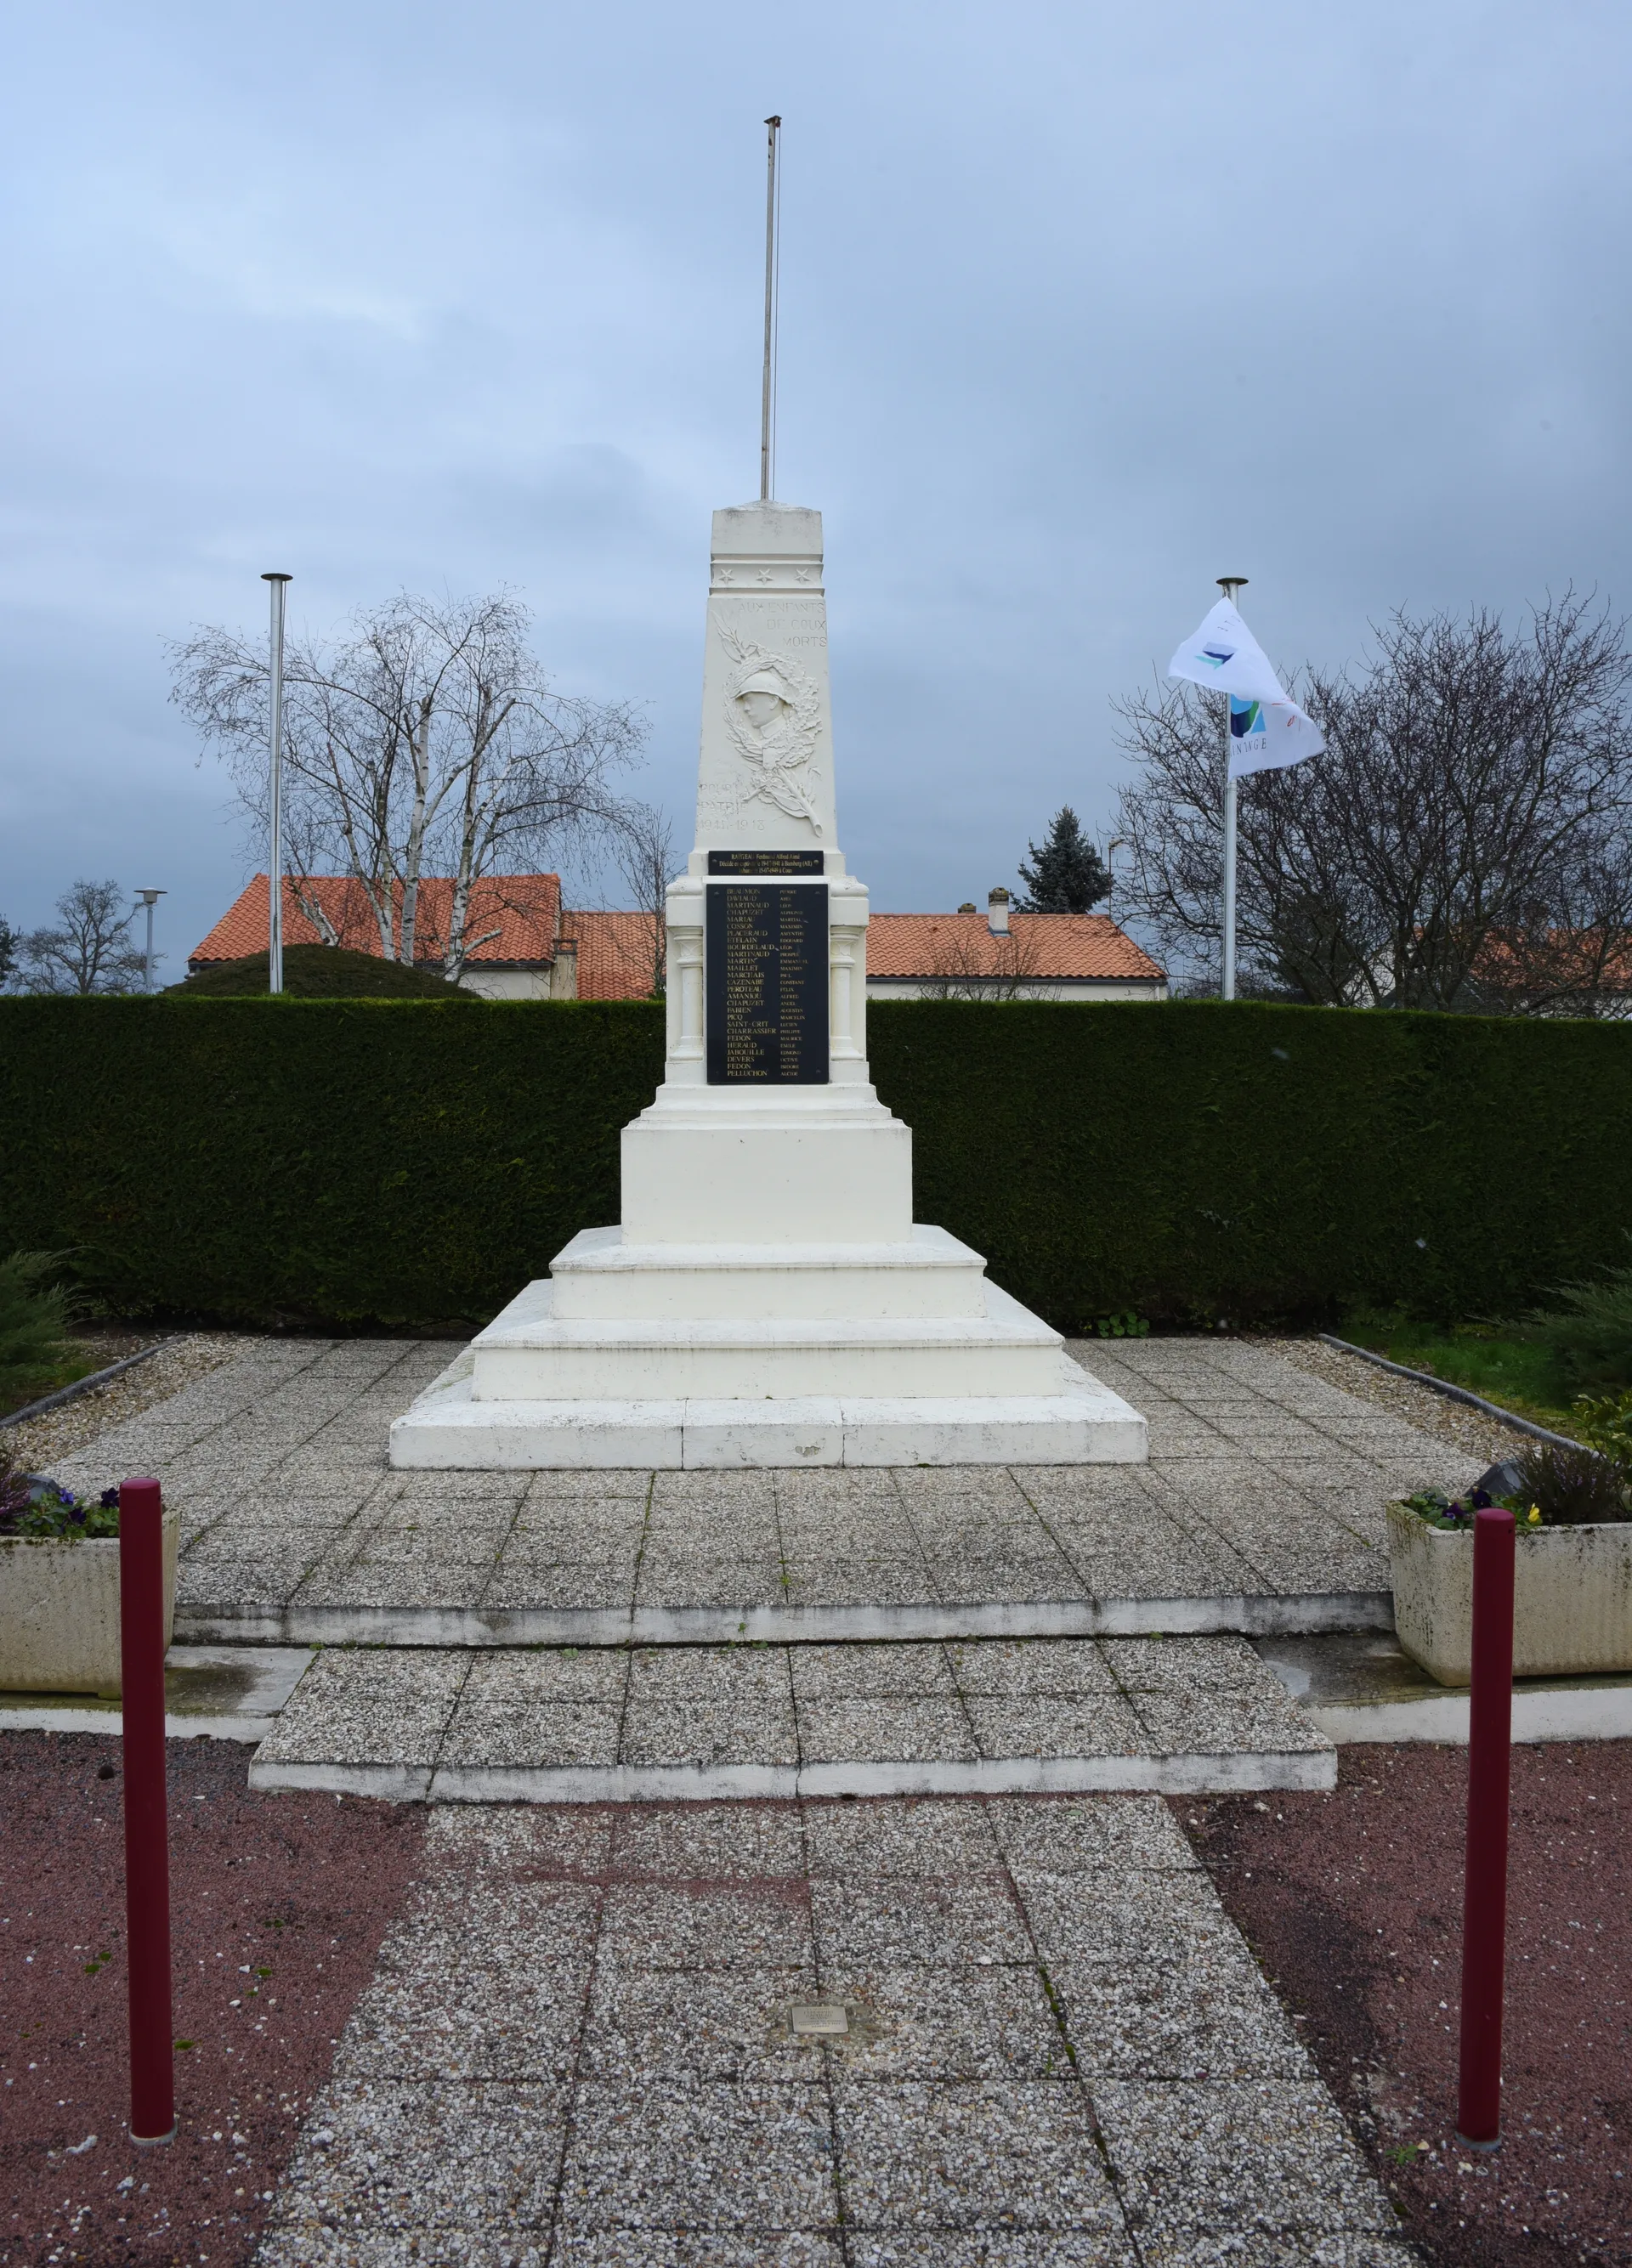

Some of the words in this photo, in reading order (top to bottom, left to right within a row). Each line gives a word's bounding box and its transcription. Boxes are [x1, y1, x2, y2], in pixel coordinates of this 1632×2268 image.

[738, 602, 765, 614] AUX
[768, 602, 825, 614] ENFANTS
[767, 619, 785, 631] DE
[790, 619, 826, 631] COUX
[783, 636, 828, 648] MORTS
[700, 801, 749, 813] PATRIE
